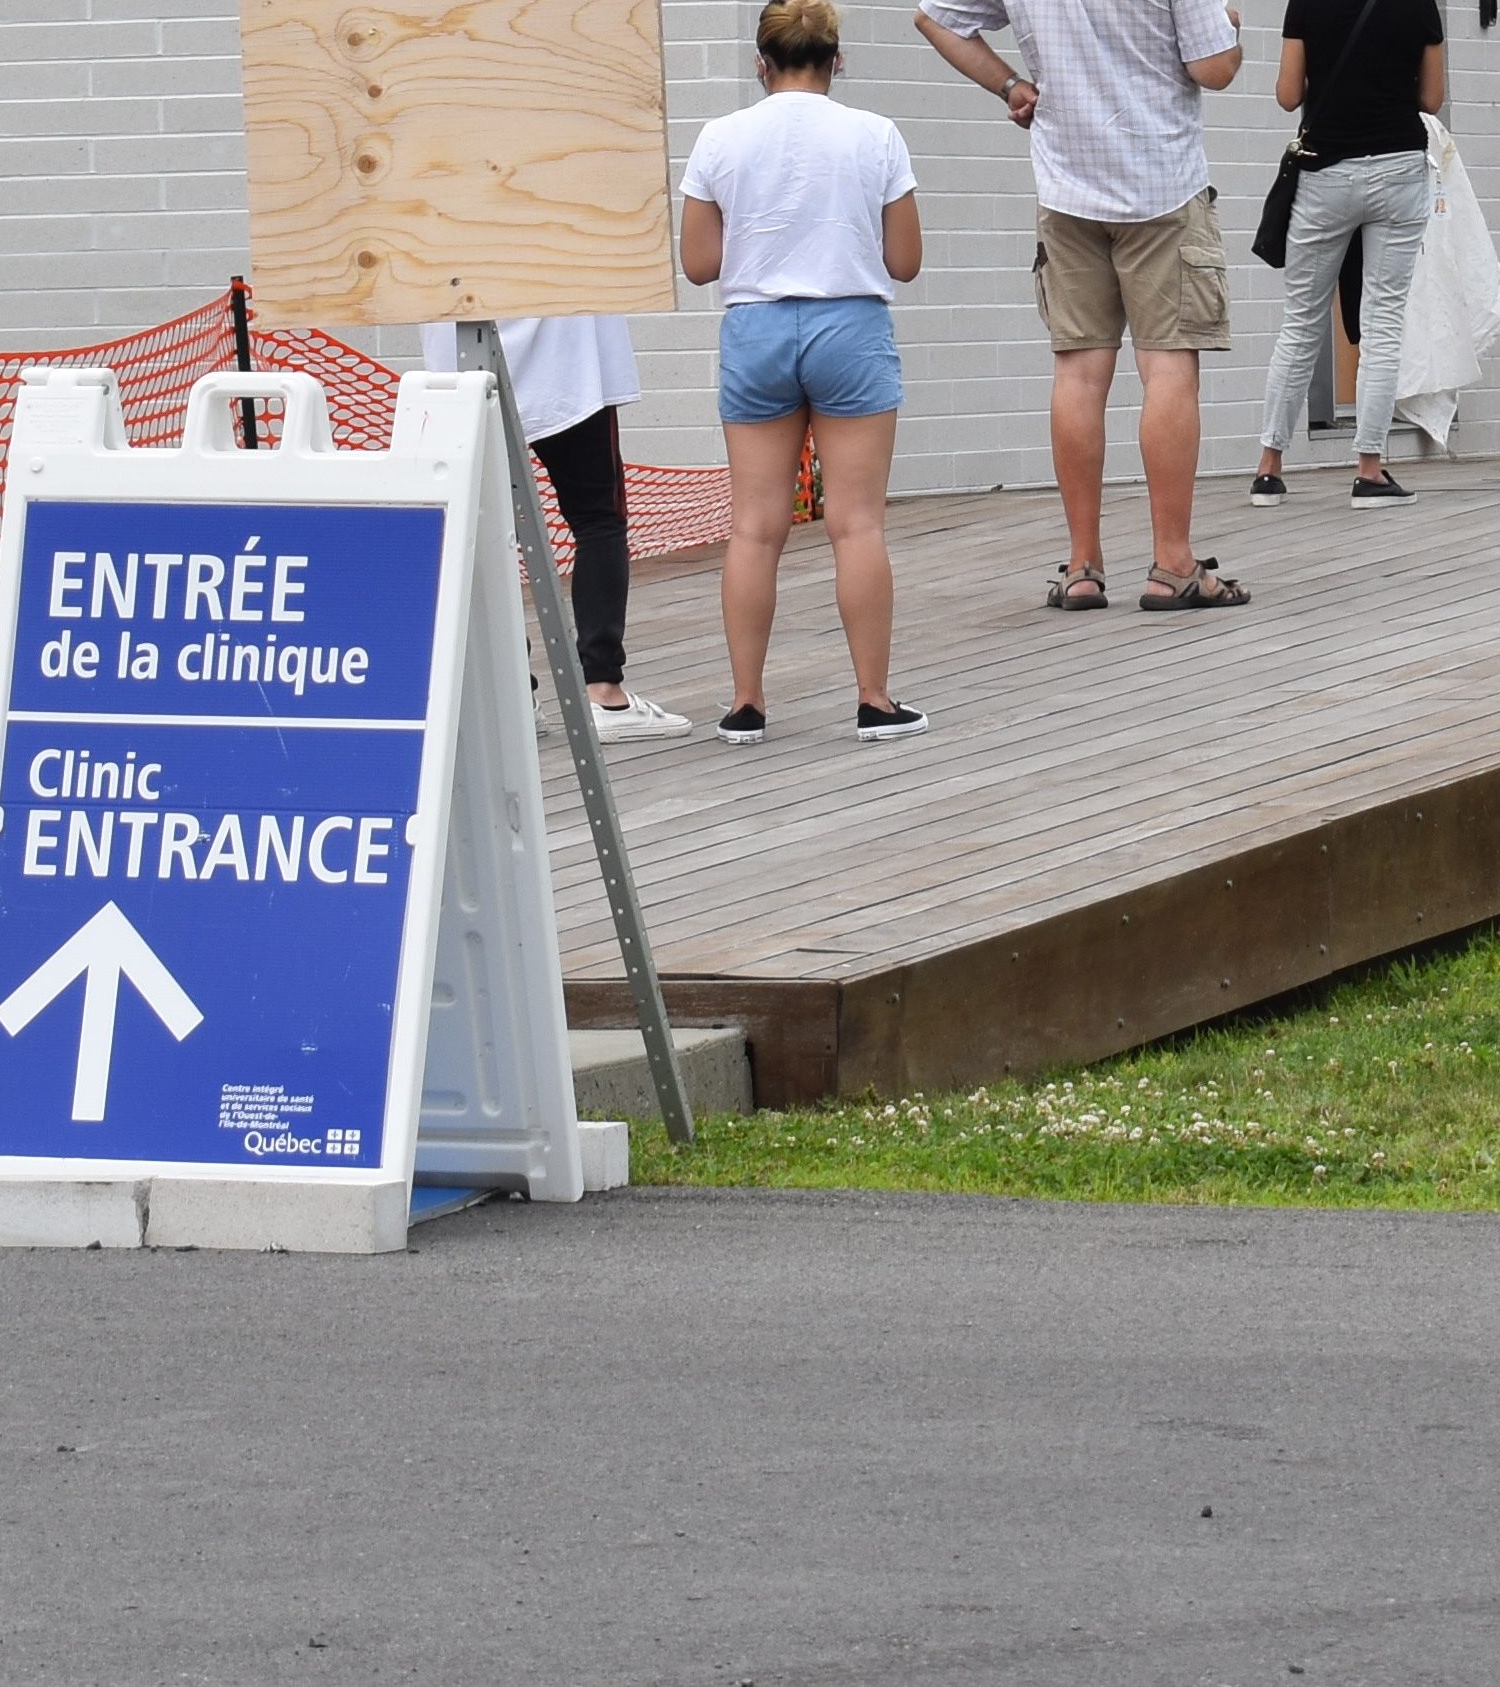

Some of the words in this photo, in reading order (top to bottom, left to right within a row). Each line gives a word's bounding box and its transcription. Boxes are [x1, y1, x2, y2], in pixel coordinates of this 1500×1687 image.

[48, 535, 309, 622] ENTRÉE
[40, 629, 99, 679] de
[117, 631, 159, 680] la
[177, 632, 370, 696] clinique
[28, 748, 162, 801] Clinic
[23, 809, 393, 885] ENTRANCE
[220, 1102, 230, 1110] et
[231, 1102, 243, 1110] de
[244, 1104, 279, 1112] services
[221, 1094, 276, 1103] universitaire
[277, 1095, 289, 1103] de
[290, 1094, 314, 1103] santé
[222, 1084, 250, 1092] Centre
[252, 1084, 284, 1095] intégré
[244, 1131, 322, 1156] Québec
